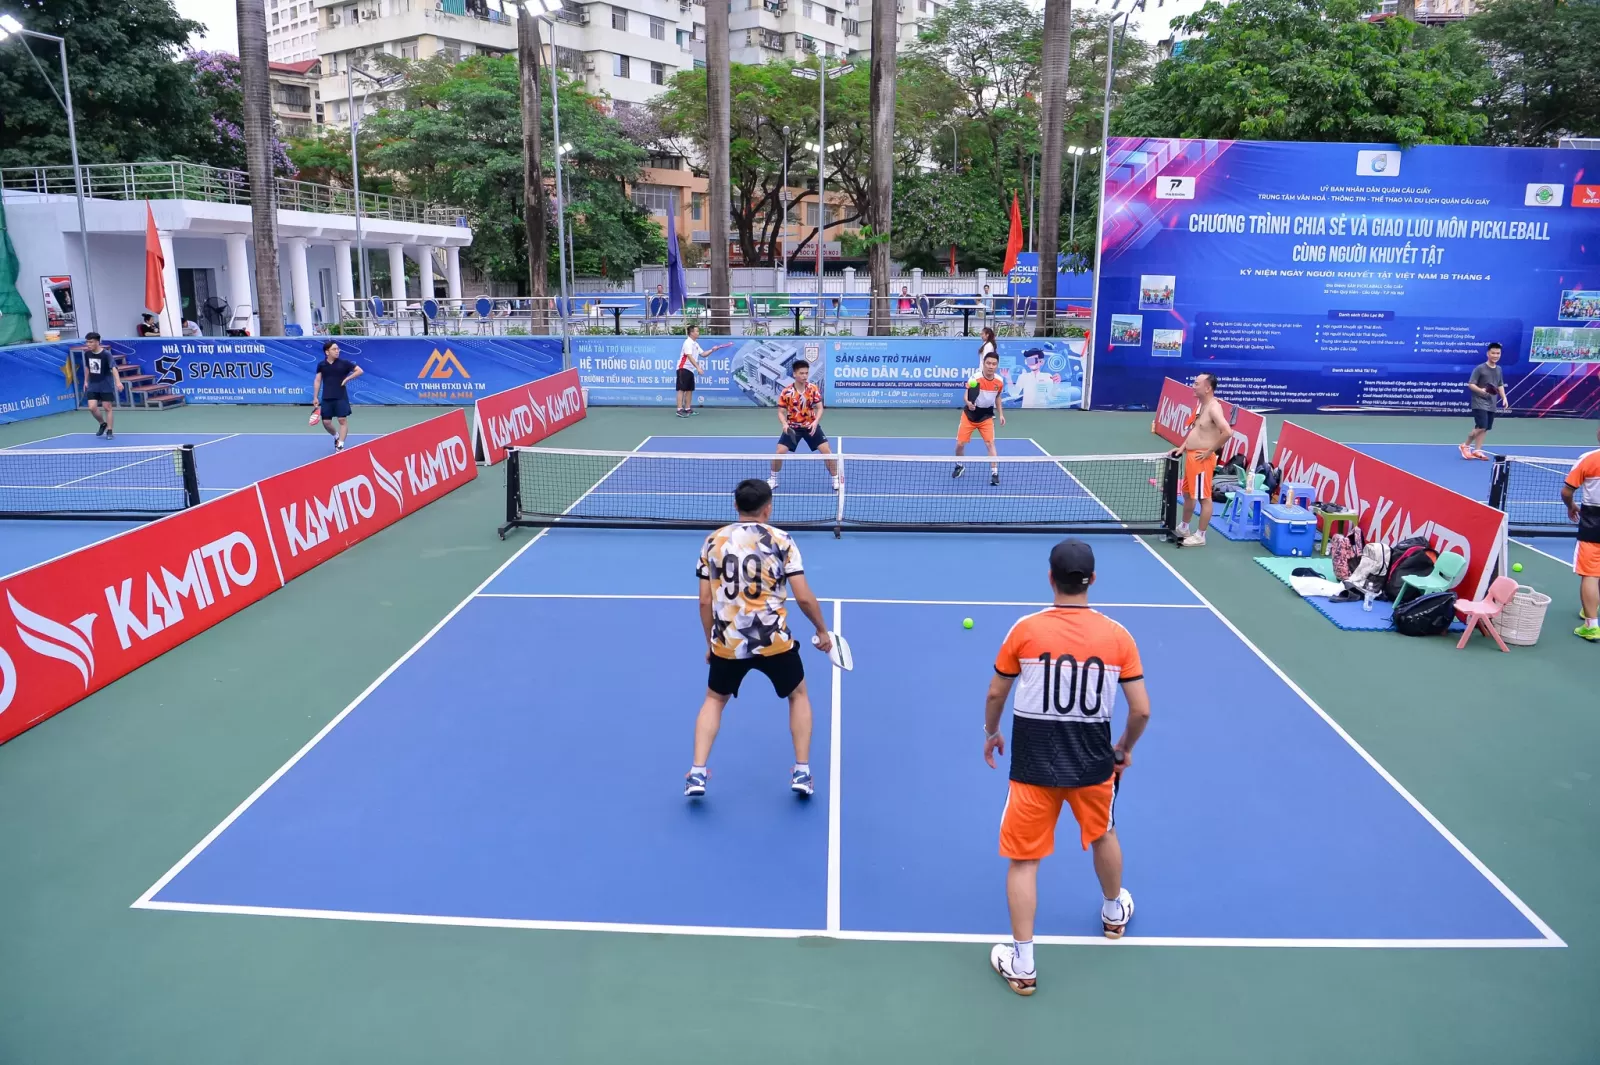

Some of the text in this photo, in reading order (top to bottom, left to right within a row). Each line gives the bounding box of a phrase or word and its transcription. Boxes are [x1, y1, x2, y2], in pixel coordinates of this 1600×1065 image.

[1189, 212, 1550, 240] CHƯƠNG TRÌNH CHIA SẺ VÀ GIAO LƯU MÔN PICKLEBALL
[1293, 241, 1444, 267] CÙNG NGƯỜI KHUYẾT TẬT
[1338, 270, 1374, 278] KHUYẾT
[1377, 270, 1392, 280] TẬT
[1395, 272, 1415, 280] VIỆT
[162, 344, 265, 354] NHÀ TÀI TRỢ KIM CƯƠNG
[579, 344, 592, 352] NHÀ
[594, 344, 604, 352] TÀI
[606, 345, 618, 355] TRỢ
[580, 356, 730, 374] HỆ THỐNG GIÁO DỤC RÍ TUỆ
[856, 355, 880, 363] SÀNG
[882, 353, 899, 363] TRỞ
[901, 354, 931, 363] THÀNH
[189, 362, 273, 378] SPARTUS
[834, 365, 868, 378] CÔNG
[872, 365, 898, 378] DÂN
[901, 368, 921, 378] 4.0
[924, 365, 958, 378] CÙNG
[580, 374, 604, 383] TRƯỜNG
[606, 373, 620, 383] TIỂU
[622, 376, 635, 385] HỌC,
[700, 376, 712, 386] TUỆ
[20, 396, 34, 410] CẦU
[36, 394, 50, 407] GIẤY
[488, 386, 580, 450] KAMITO KAMITO
[104, 435, 467, 650] KAMITO KAMITO KAMITO
[722, 553, 761, 600] 99
[1039, 651, 1105, 716] 100
